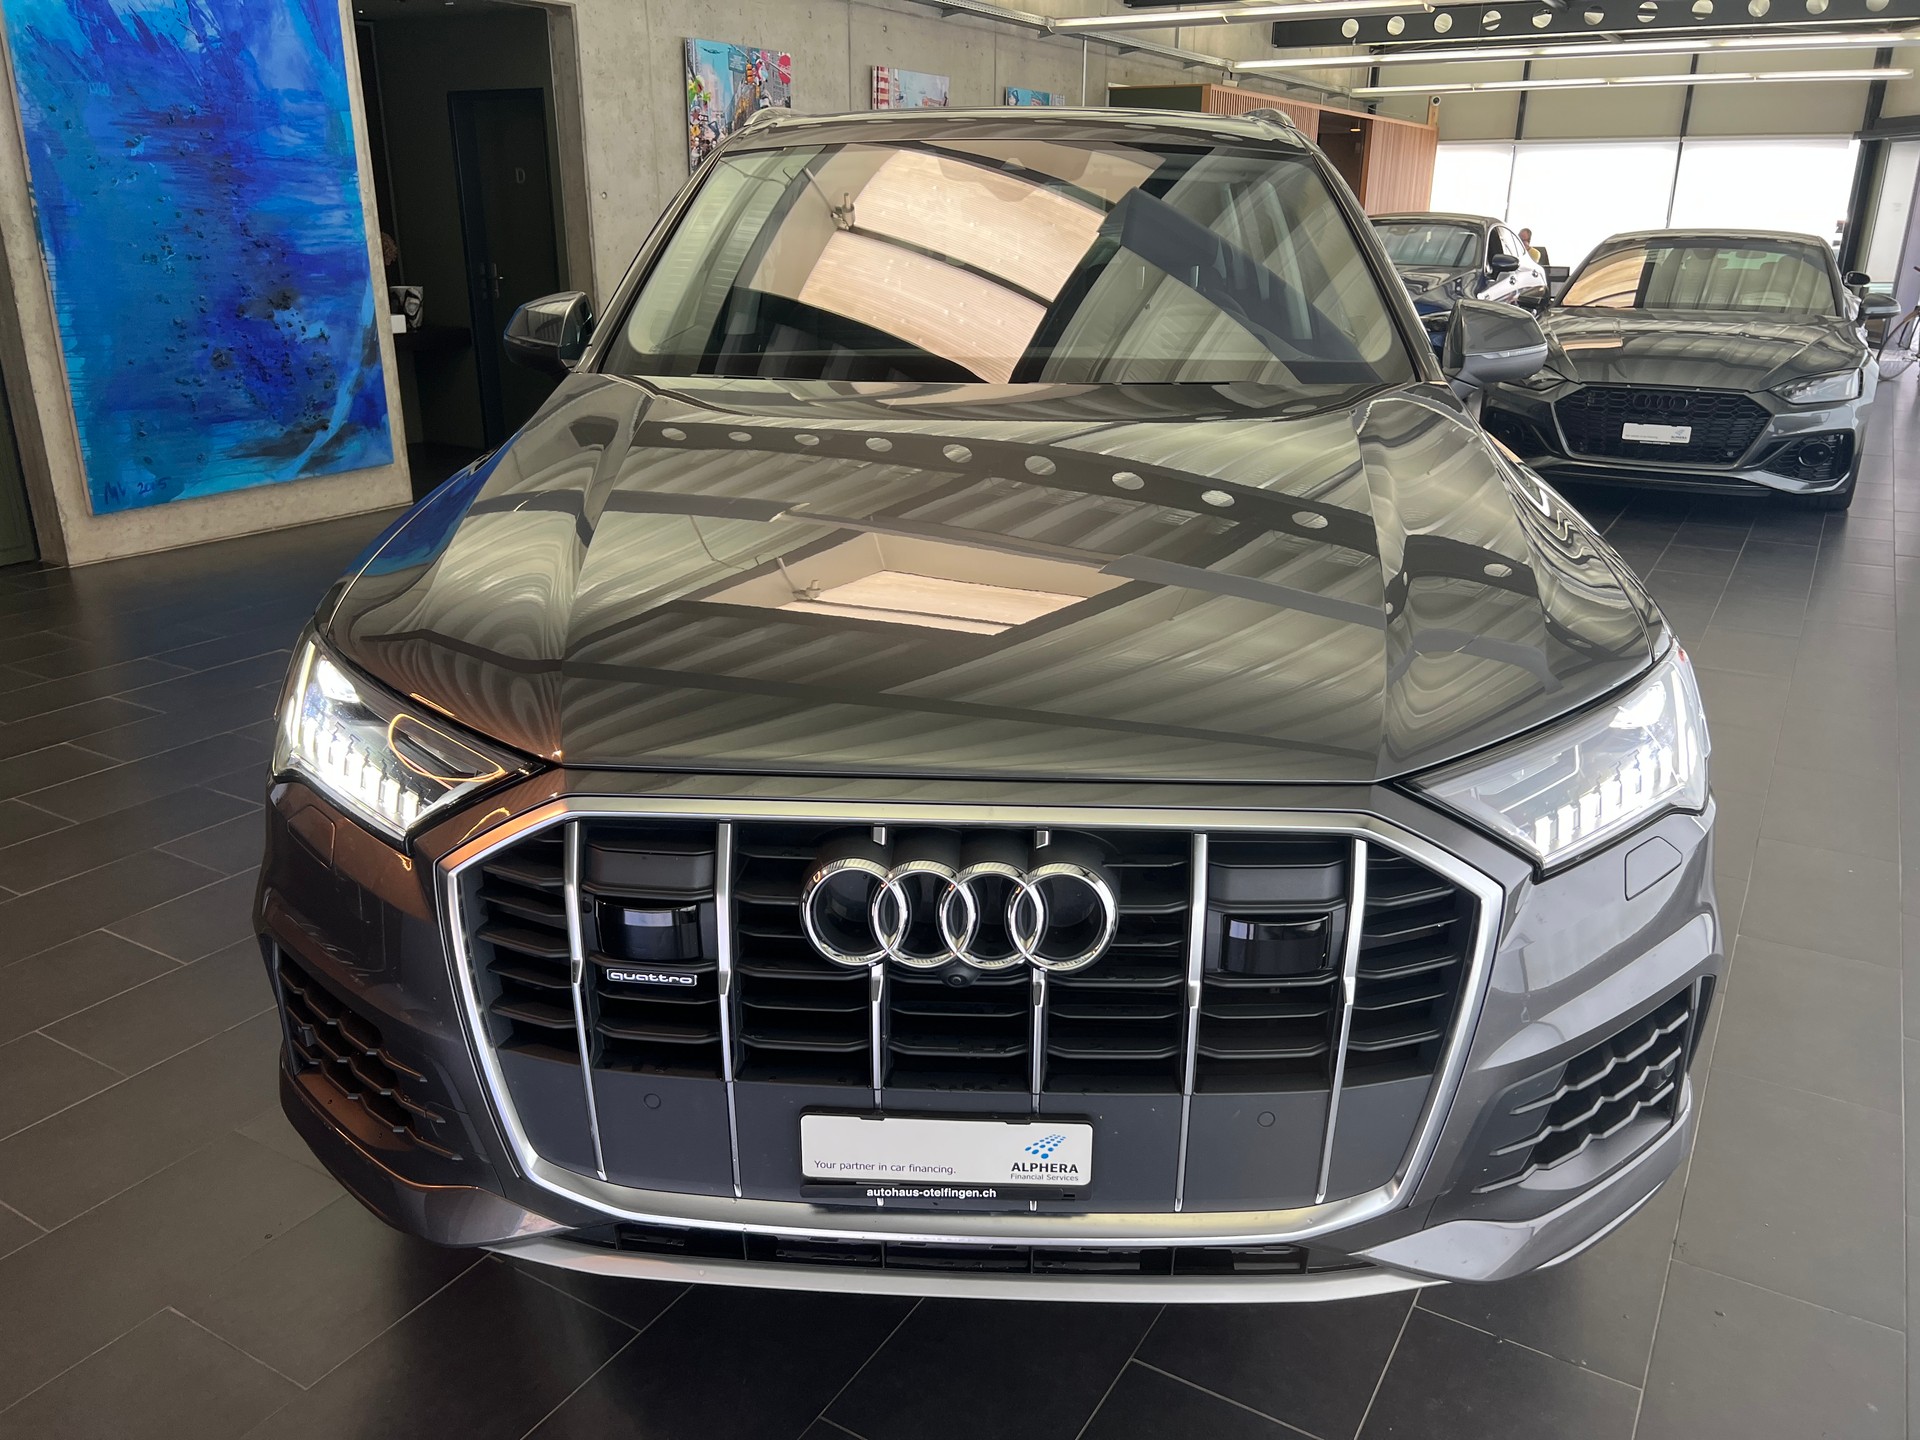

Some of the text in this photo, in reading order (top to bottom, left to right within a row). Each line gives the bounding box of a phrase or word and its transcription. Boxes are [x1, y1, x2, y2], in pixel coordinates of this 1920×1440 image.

[610, 972, 693, 984] quattro
[814, 1160, 956, 1175] Your partner in car financing.
[1011, 1162, 1079, 1173] ALPHERA
[866, 1187, 997, 1199] autohaus-otelfingen.ch
